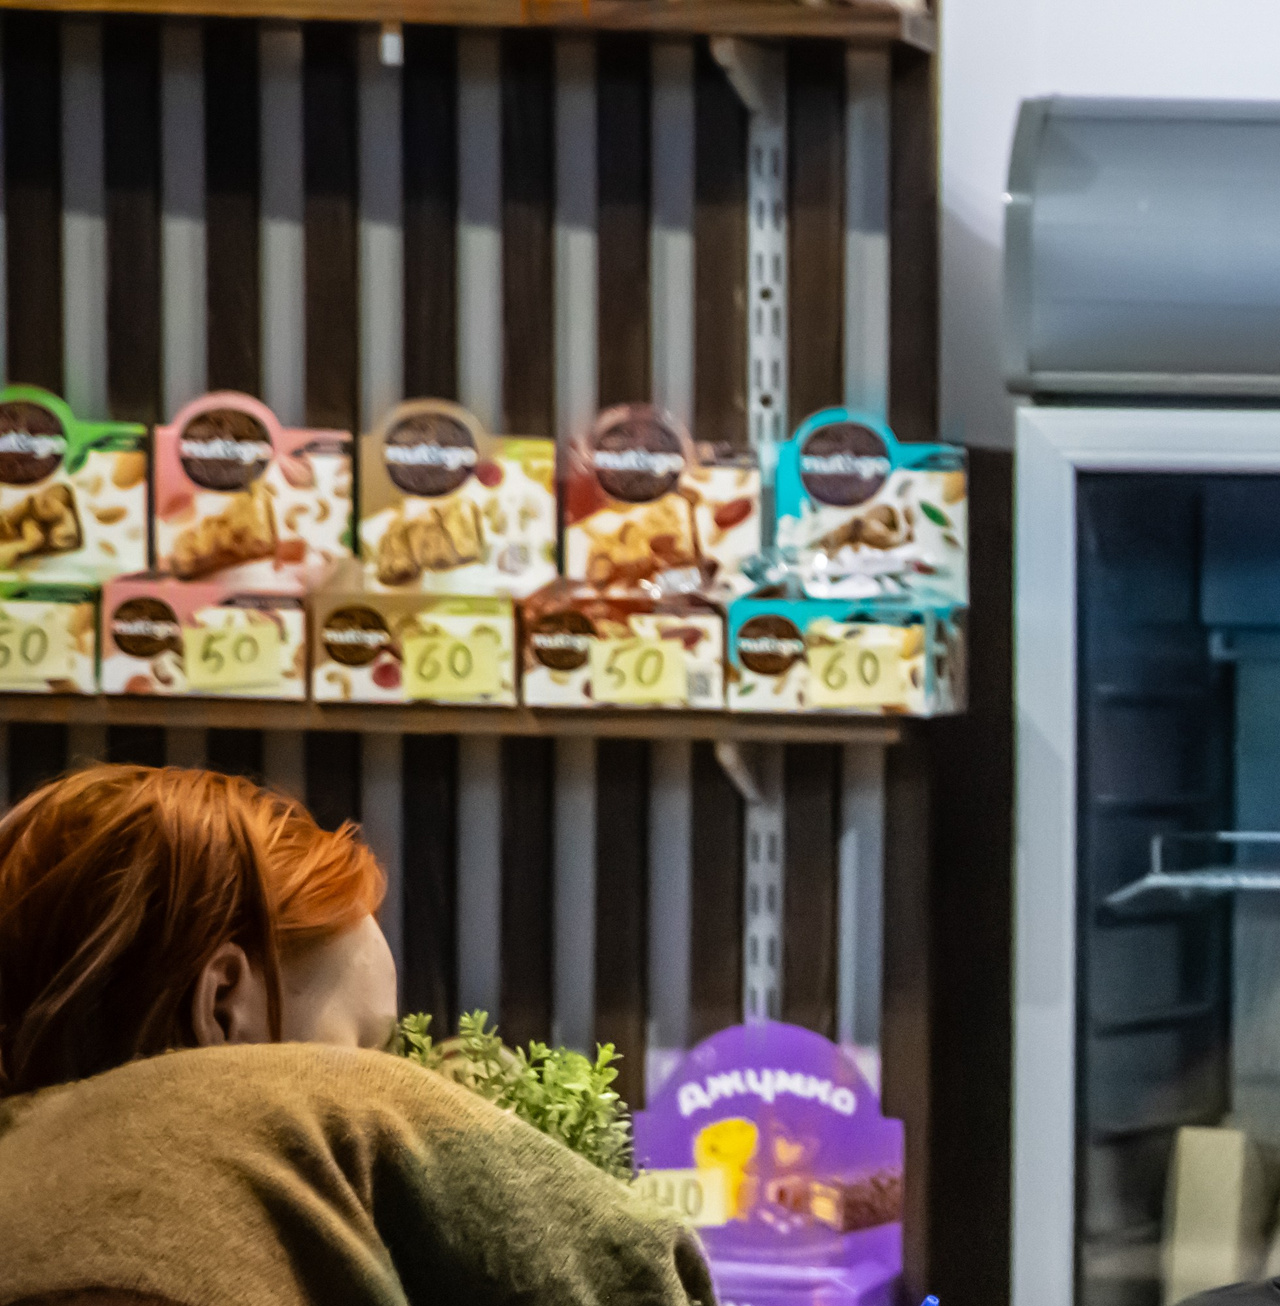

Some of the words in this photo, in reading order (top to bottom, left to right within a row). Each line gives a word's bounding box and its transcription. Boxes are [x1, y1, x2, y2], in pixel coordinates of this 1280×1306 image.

[201, 632, 260, 674] 50
[415, 641, 473, 682] 60
[604, 640, 664, 691] 50
[821, 648, 880, 692] 60
